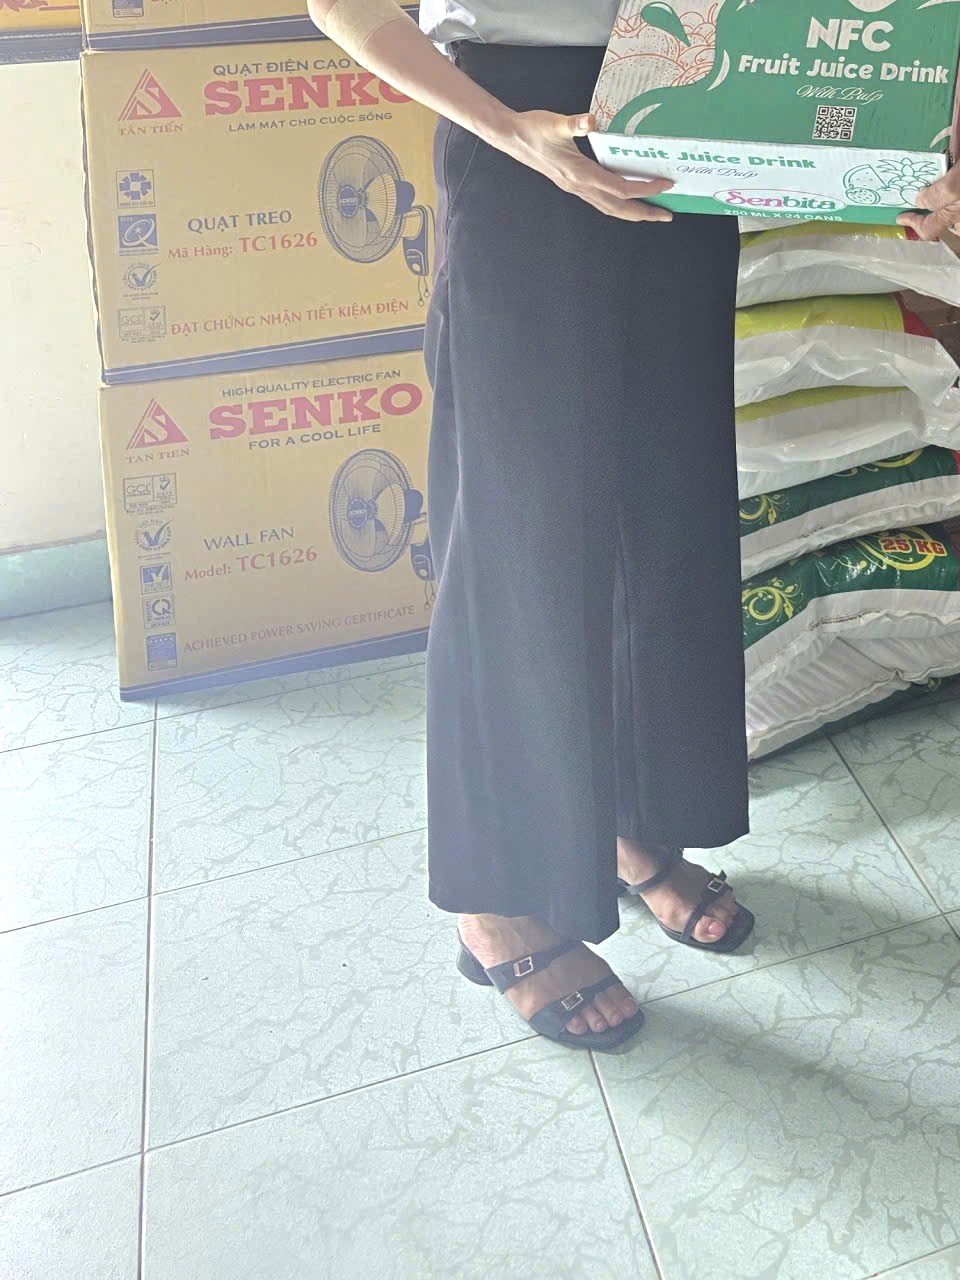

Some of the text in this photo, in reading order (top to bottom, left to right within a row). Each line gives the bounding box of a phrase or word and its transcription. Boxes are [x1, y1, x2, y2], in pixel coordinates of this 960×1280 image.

[806, 16, 894, 52] NFC
[213, 58, 350, 77] QUẠT ĐIỆN CAO
[738, 53, 950, 84] Fruit Juice Drink
[795, 84, 884, 105] With Pulp
[229, 111, 393, 132] LÀM MÁT CHO CUỘC SỐNG
[608, 146, 817, 169] Fruit Juice Drink
[715, 168, 758, 180] Pulp
[727, 191, 837, 210] Senbita
[187, 209, 292, 234] QUẠT TREO
[168, 231, 318, 259] Mã Hàng: TC1626
[171, 298, 409, 337] ĐẠT CHỨNG NHẬN TIẾT KIỆM ĐIỆN
[222, 369, 401, 399] HIGH QUALITY ELECTRIC FAN
[209, 382, 423, 441] SENKO
[249, 424, 382, 450] FOR A COOL LIFE
[203, 526, 295, 551] WALL FAN
[880, 537, 947, 556] 25 KG
[185, 545, 318, 581] Model: TC1626
[184, 604, 415, 653] ACHIEVED POWER SAVING CERTIFICATE
